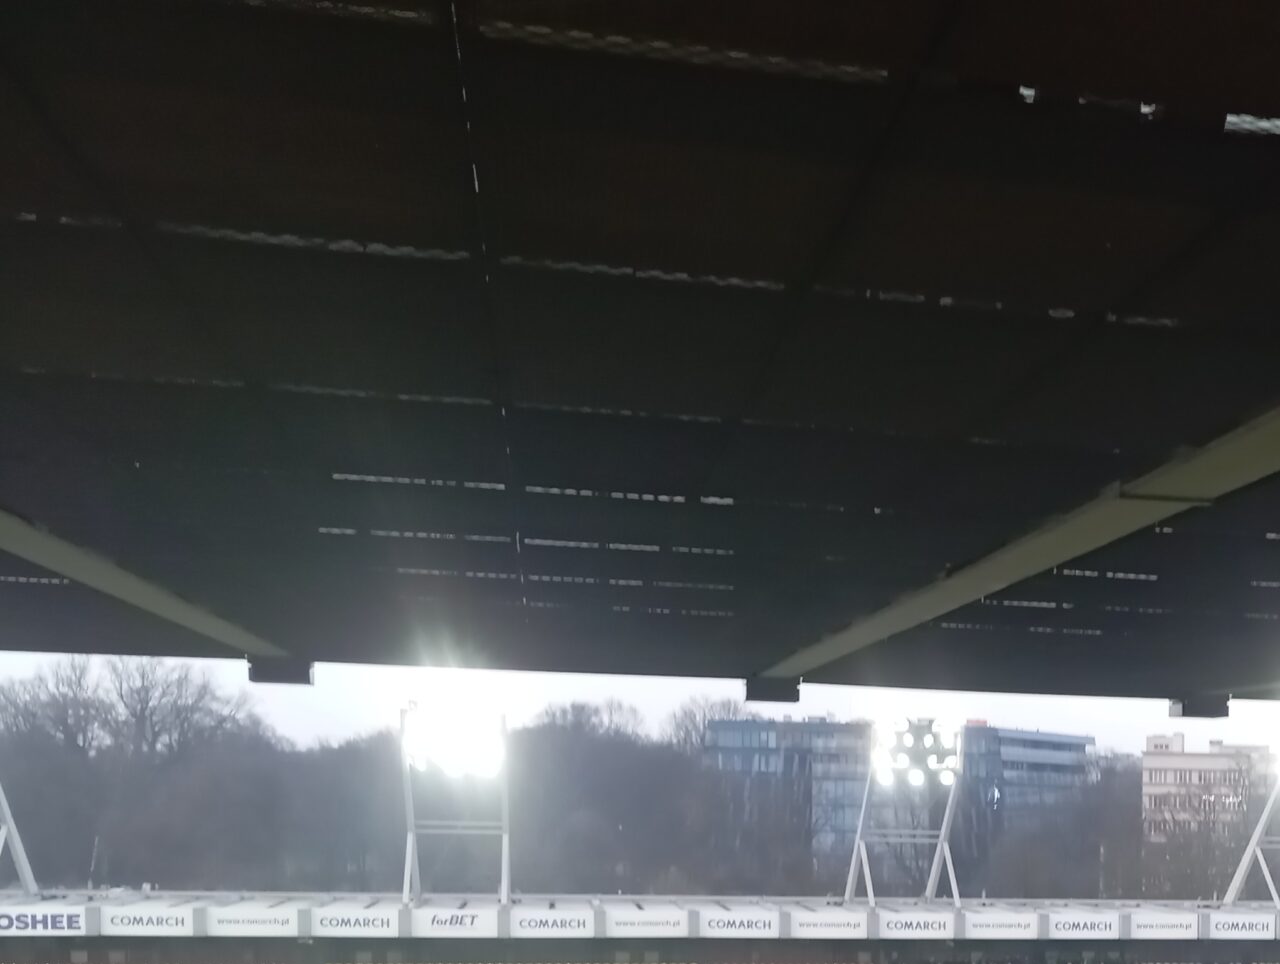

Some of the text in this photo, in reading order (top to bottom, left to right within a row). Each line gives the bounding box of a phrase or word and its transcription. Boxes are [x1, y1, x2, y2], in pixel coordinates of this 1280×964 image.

[0, 913, 82, 931] OSHEE
[110, 913, 185, 928] COMARCH
[319, 917, 390, 929] COMARCH
[519, 918, 587, 930] COMARCH
[708, 919, 772, 930] COMARCH
[886, 920, 947, 931] COMARCH
[1055, 921, 1112, 932] COMARCH
[1215, 922, 1269, 932] COMARCH
